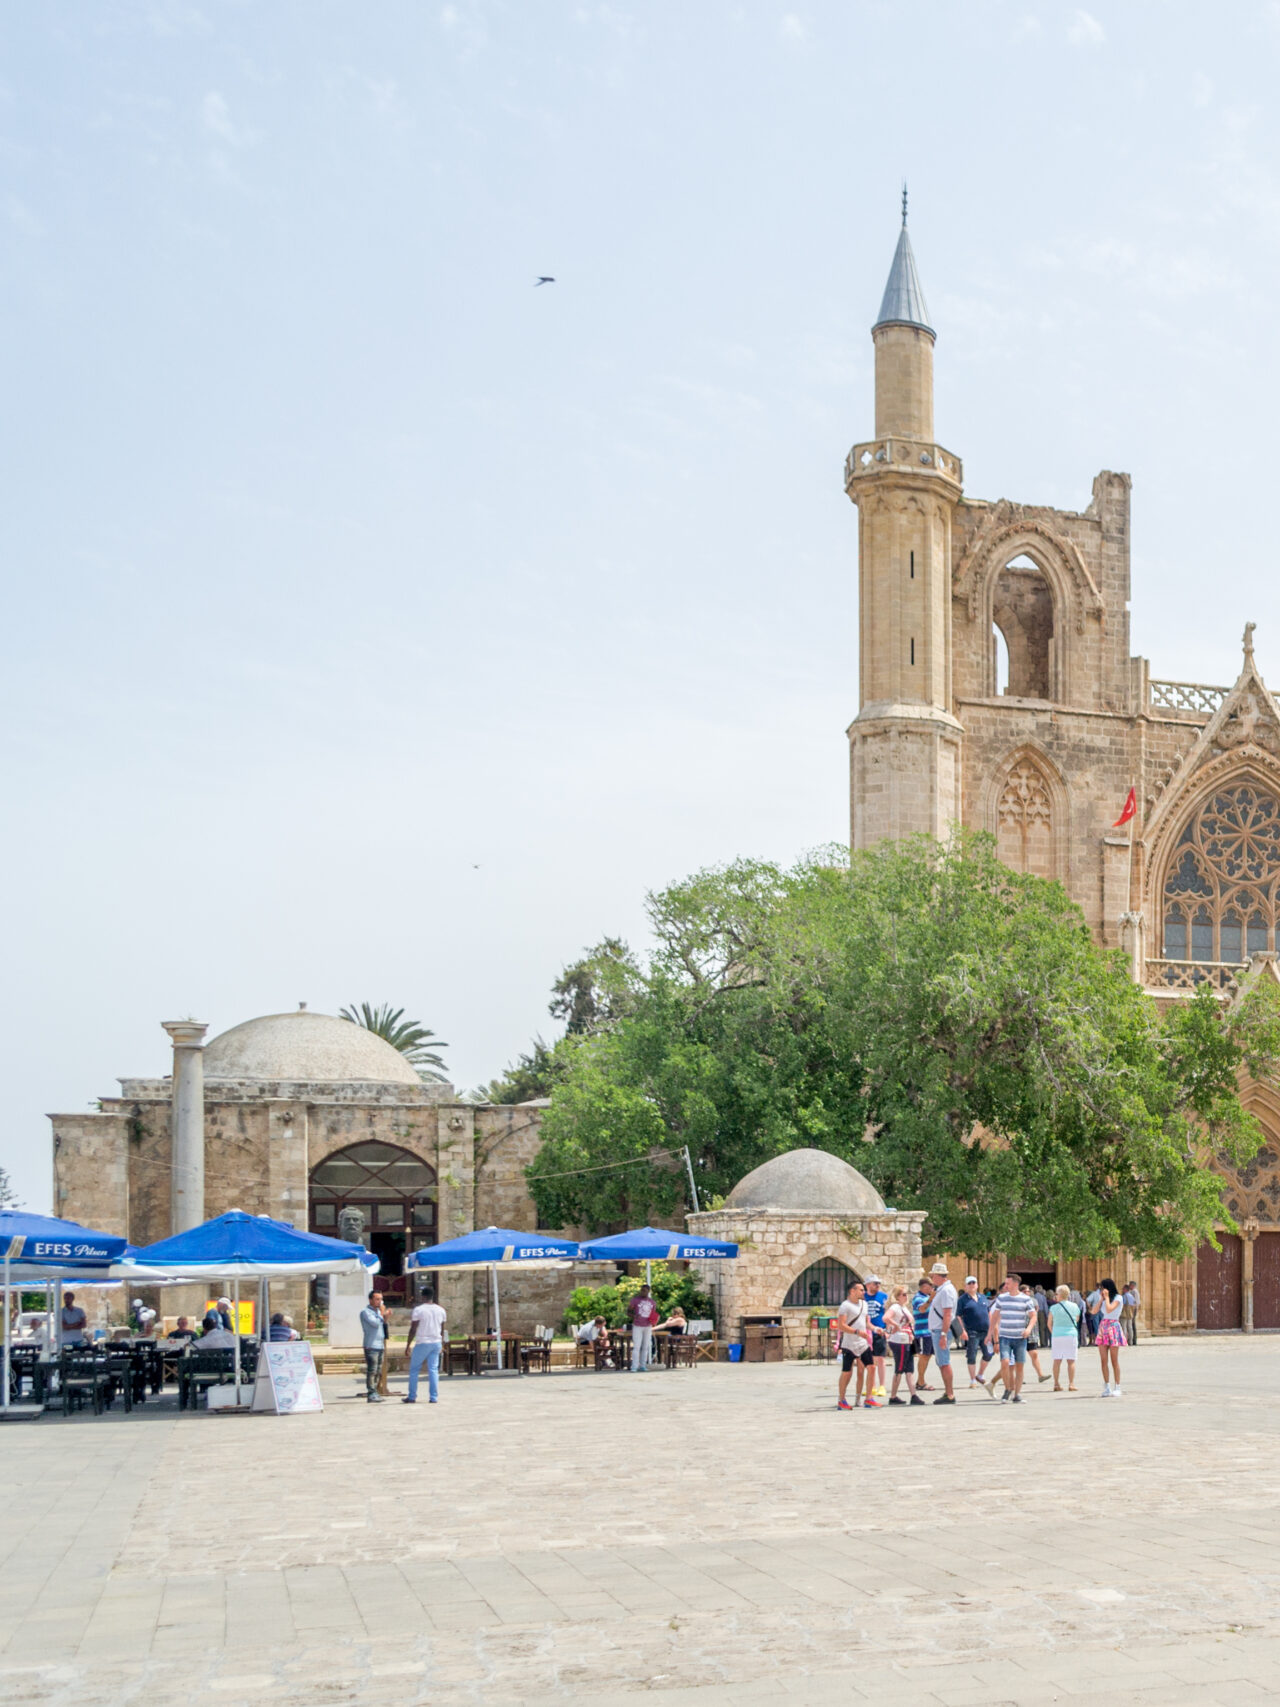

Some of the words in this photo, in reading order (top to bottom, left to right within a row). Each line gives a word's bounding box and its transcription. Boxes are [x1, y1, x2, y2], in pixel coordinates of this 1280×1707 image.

[35, 1242, 71, 1256] EFES
[74, 1244, 108, 1256] Pilsen
[520, 1248, 544, 1257] EFES
[683, 1248, 706, 1257] EFES
